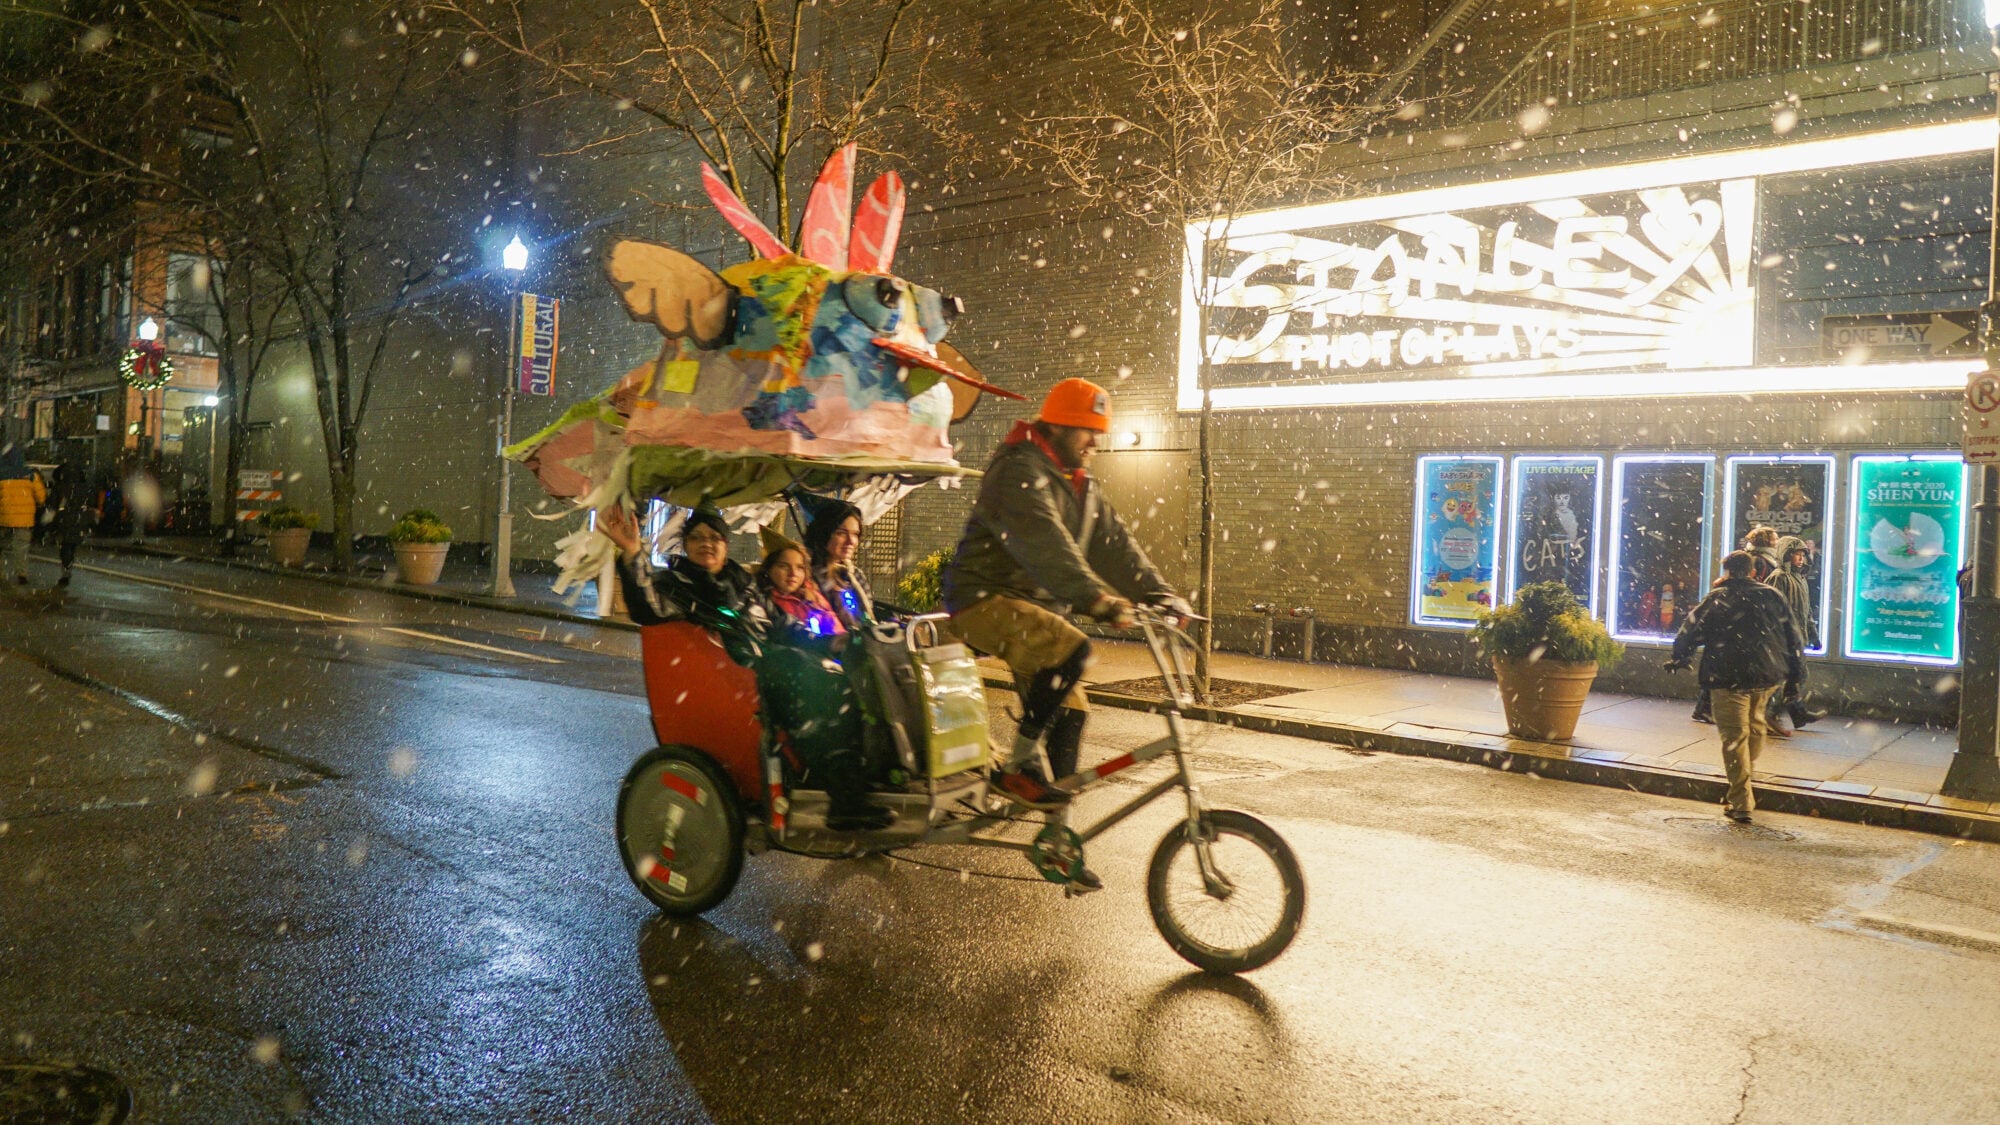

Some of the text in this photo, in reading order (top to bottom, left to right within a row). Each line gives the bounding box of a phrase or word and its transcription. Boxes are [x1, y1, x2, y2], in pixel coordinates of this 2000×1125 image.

[1206, 199, 1722, 358] STANLEY
[524, 295, 536, 355] DISTRICT
[1838, 325, 1930, 345] ONE WAY
[530, 298, 555, 396] CULTURAL
[1288, 318, 1585, 371] PHOTOPLAYS
[1526, 466, 1547, 475] LIVE
[1548, 466, 1562, 475] ON
[1867, 489, 1955, 501] SHEN YUN
[1745, 509, 1812, 524] dancing
[1522, 536, 1587, 572] CATS
